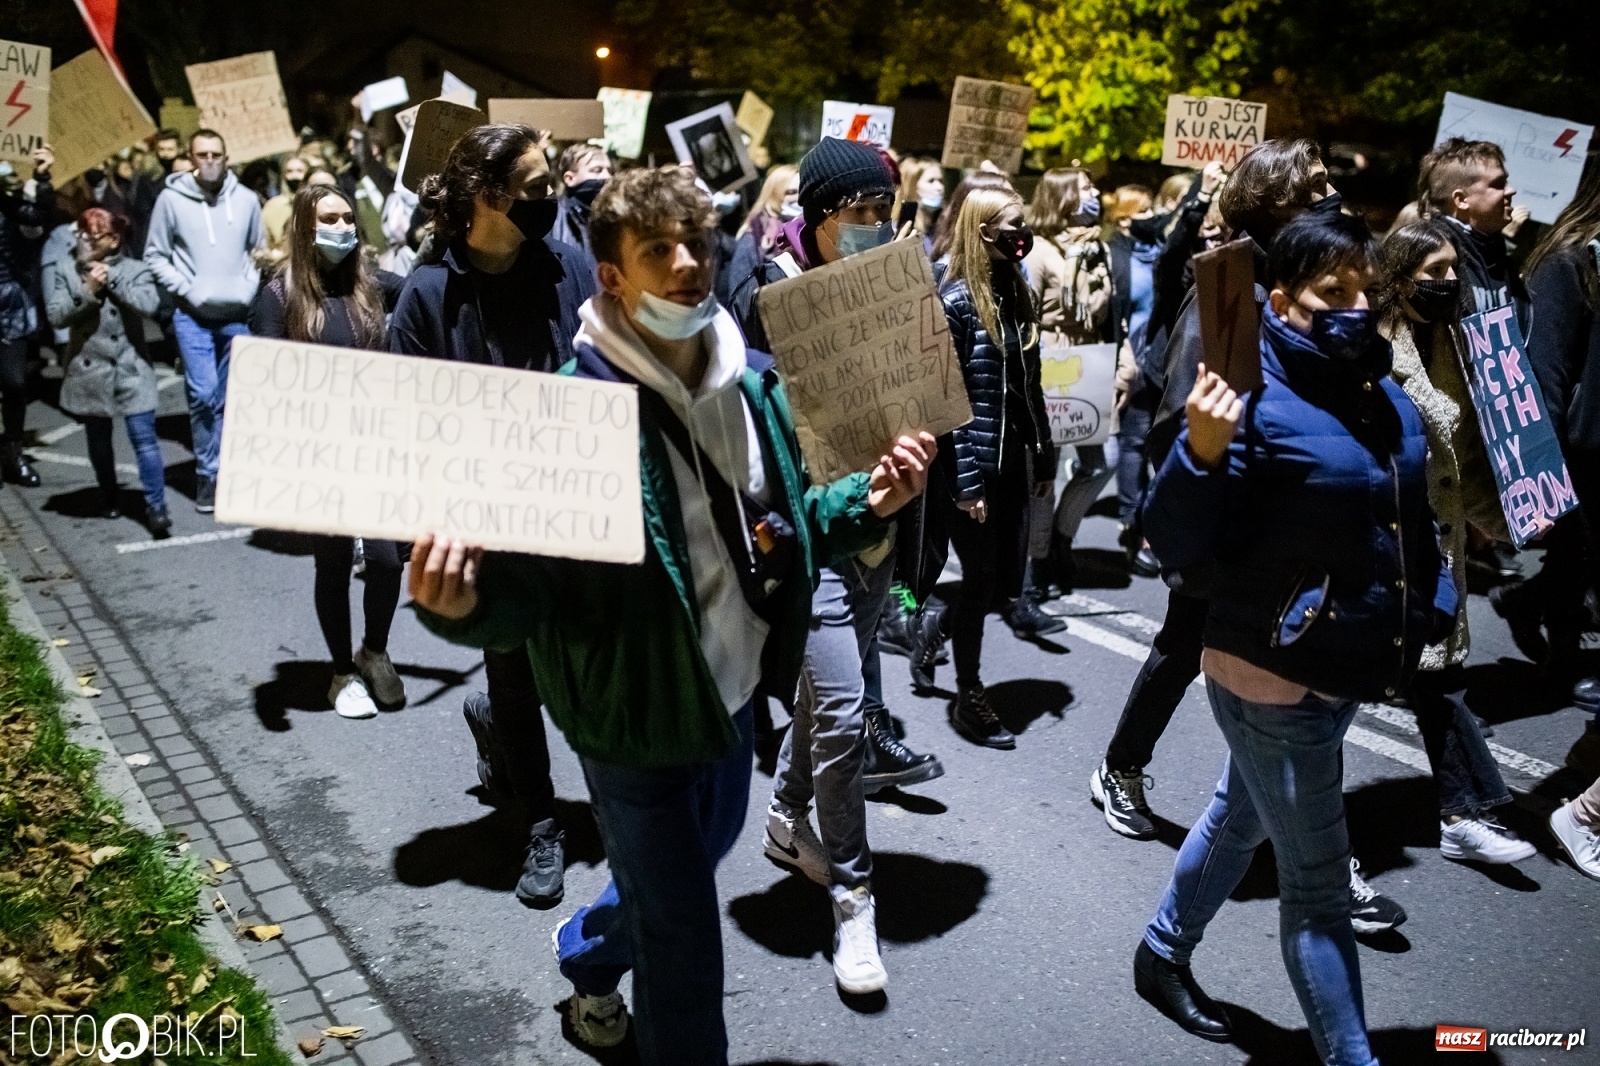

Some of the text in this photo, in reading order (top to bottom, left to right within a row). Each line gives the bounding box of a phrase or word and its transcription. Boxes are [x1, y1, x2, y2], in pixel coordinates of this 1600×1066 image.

[1175, 118, 1259, 144] KURWA
[1184, 100, 1263, 123] TO JEST
[1176, 140, 1252, 164] DRAMAT
[762, 246, 927, 342] MORAWIECKI
[810, 329, 842, 363] NIC
[875, 300, 915, 333] MASZ
[786, 334, 914, 407] OKULARY I TAK
[233, 390, 600, 461] RYMU NIE DO TAKTU
[537, 383, 584, 423] NIE
[588, 388, 631, 431] DO
[227, 431, 623, 501] PRZYKLEIMY CIĘ SZMATO
[1492, 434, 1526, 485] MY
[376, 489, 425, 527] DO
[444, 496, 611, 543] KONTAKTU
